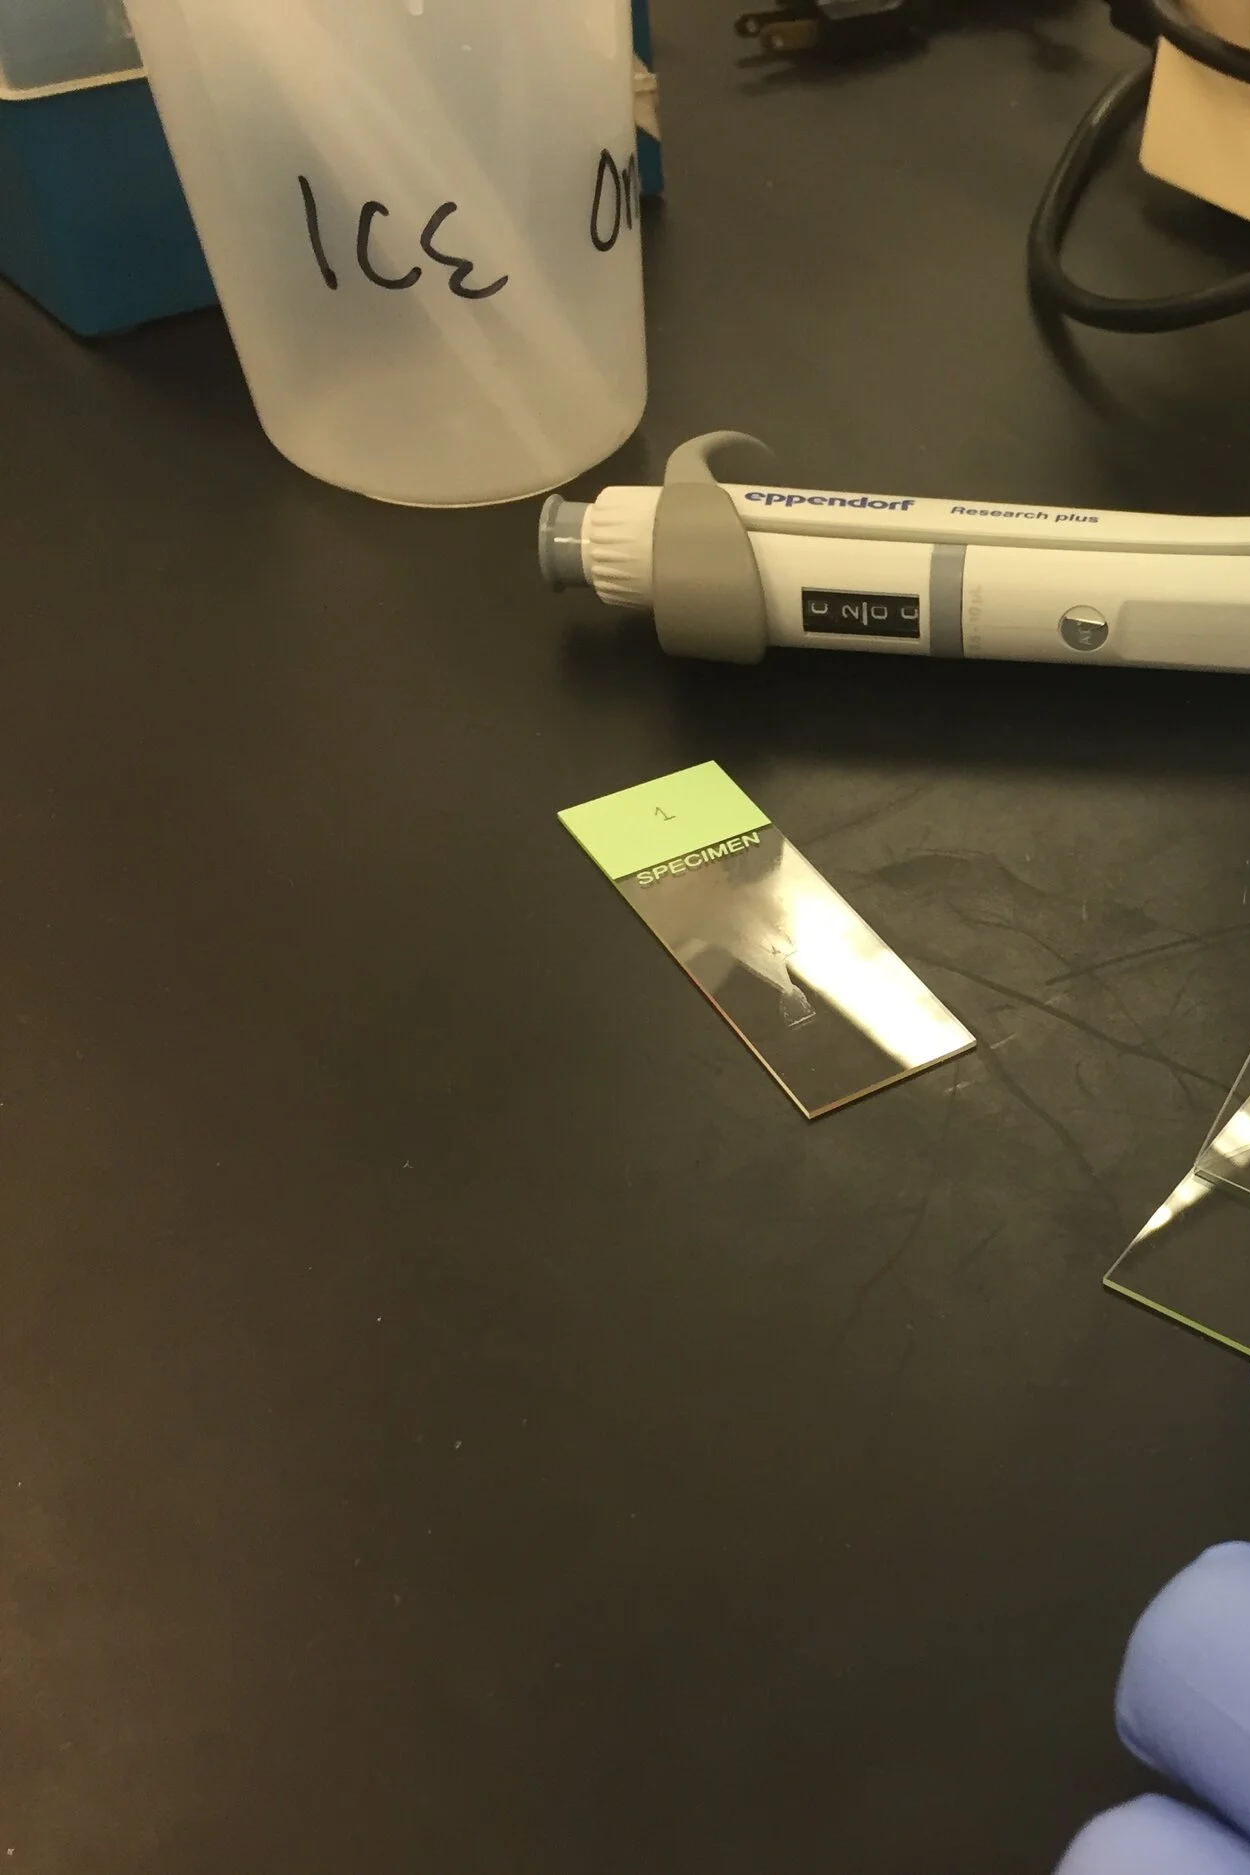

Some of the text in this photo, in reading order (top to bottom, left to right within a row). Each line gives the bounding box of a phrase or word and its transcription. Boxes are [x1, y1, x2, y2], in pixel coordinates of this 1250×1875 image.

[299, 175, 509, 299] ICE
[744, 491, 916, 512] eppendorf
[950, 506, 1099, 523] Research plus
[654, 806, 677, 821] 1
[636, 832, 761, 885] SPECIMEN
